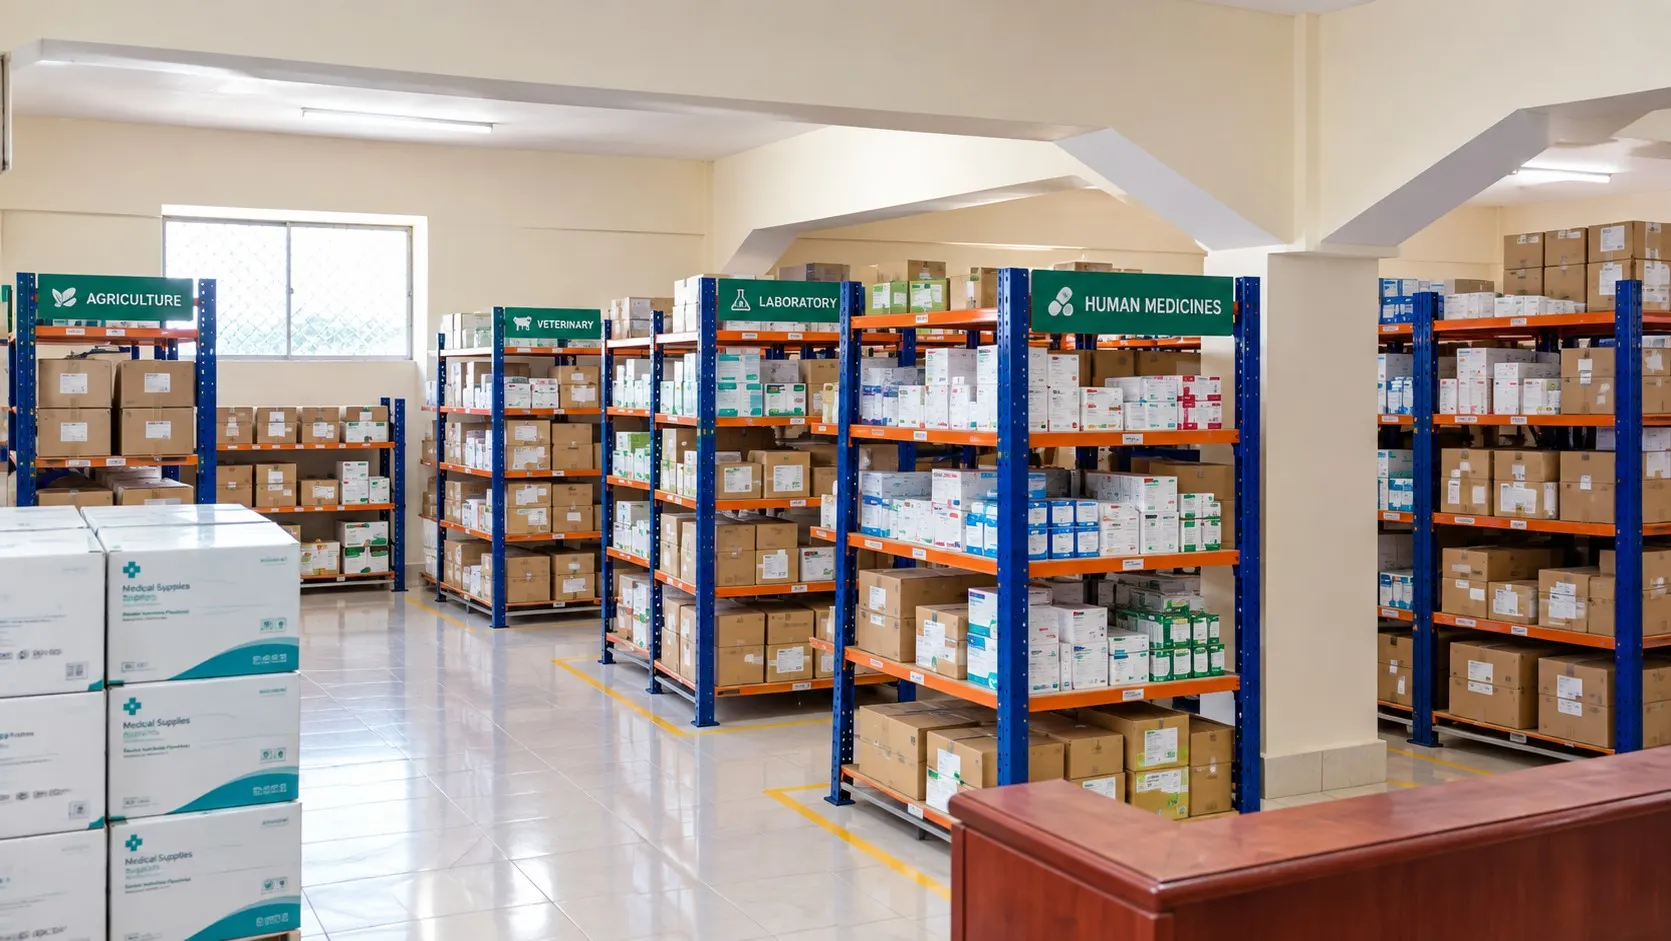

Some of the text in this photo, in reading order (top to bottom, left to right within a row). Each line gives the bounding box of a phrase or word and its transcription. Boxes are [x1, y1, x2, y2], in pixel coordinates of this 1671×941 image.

[86, 292, 182, 307] AGRICULTURE
[759, 296, 838, 309] LABORATORY
[1084, 296, 1222, 315] HUMAN MEDICINES
[537, 319, 594, 329] VETERINARY
[122, 717, 191, 729] Medical Supplies
